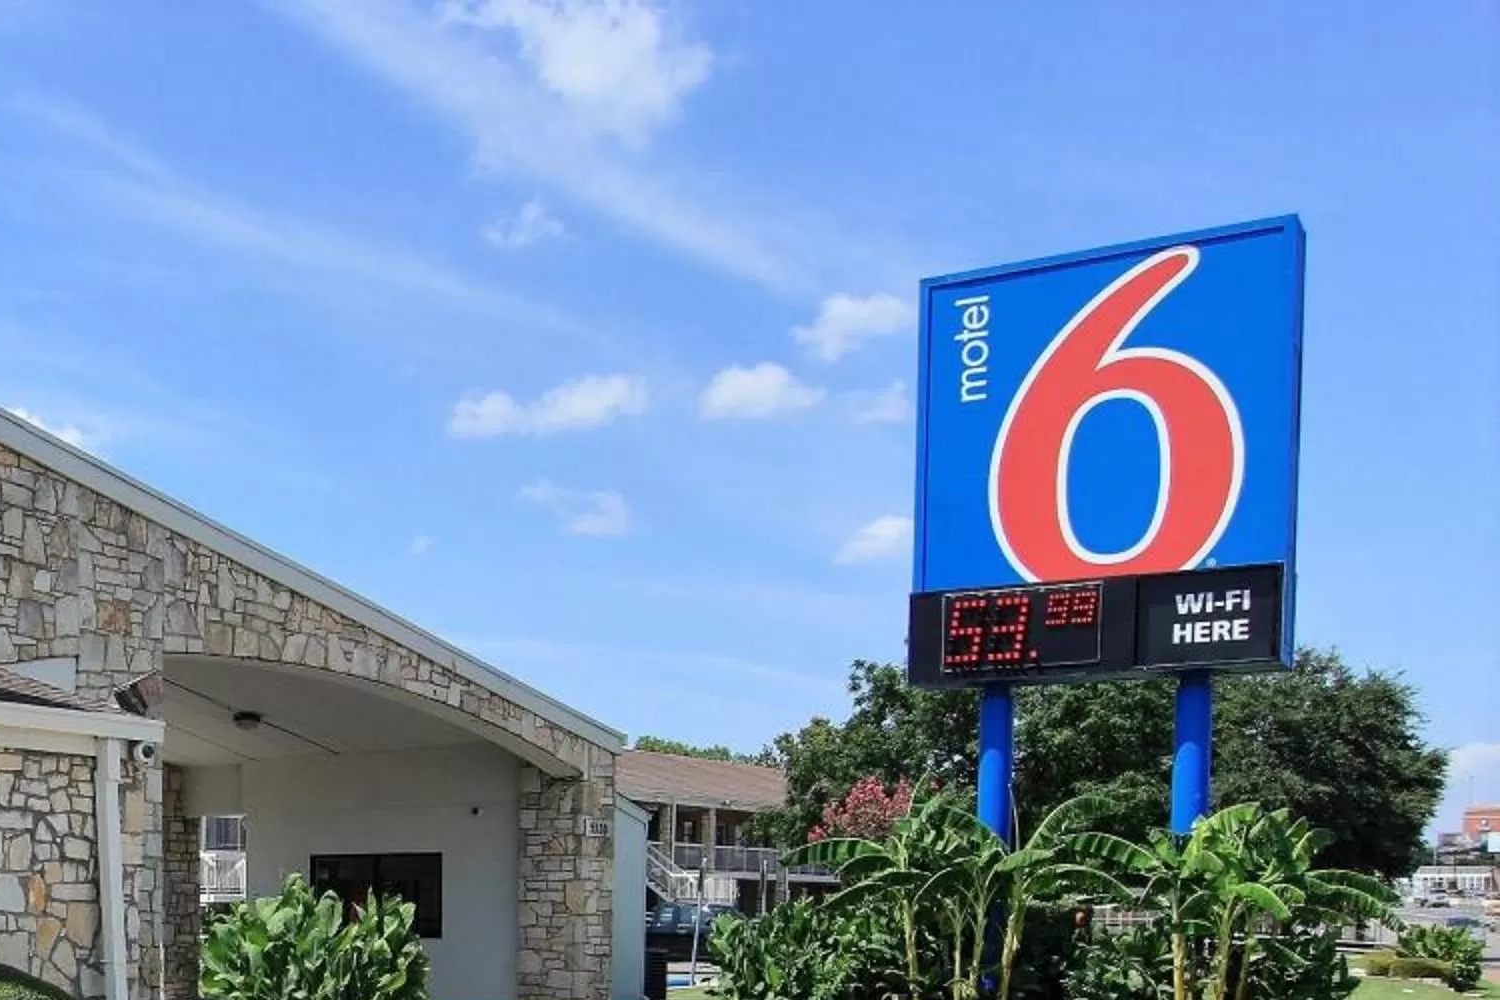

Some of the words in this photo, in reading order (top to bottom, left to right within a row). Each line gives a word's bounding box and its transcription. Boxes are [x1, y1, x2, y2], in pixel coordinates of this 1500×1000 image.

[954, 296, 989, 402] motel
[988, 245, 1244, 582] 6
[1172, 618, 1251, 644] HERE
[1175, 589, 1251, 615] WI-FI
